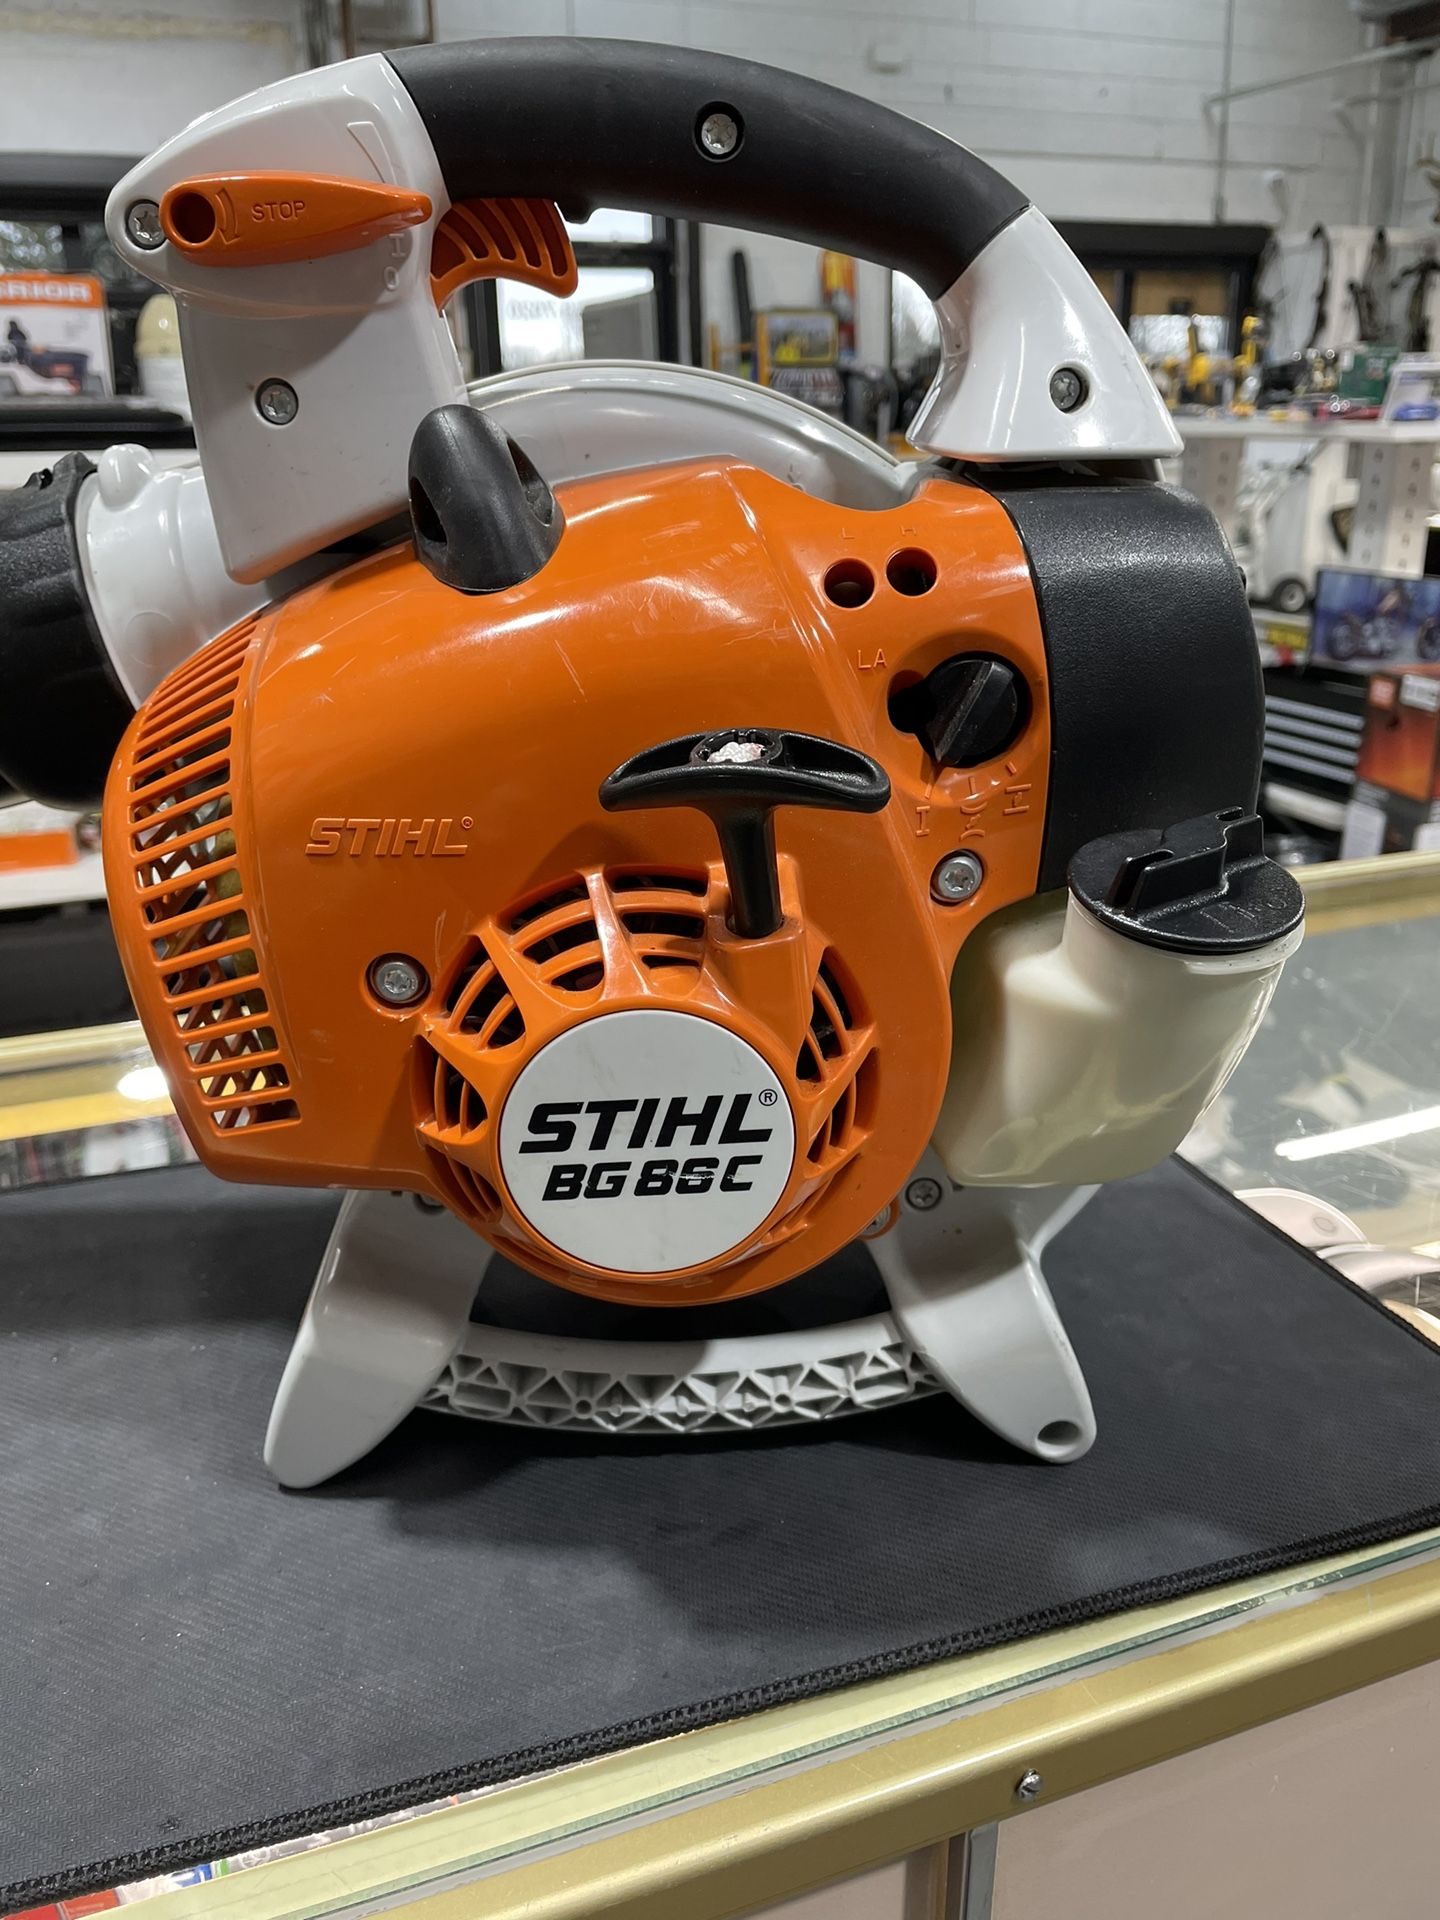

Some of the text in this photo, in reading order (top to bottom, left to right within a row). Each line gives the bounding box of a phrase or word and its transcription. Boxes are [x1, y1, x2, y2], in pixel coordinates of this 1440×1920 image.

[251, 200, 306, 223] STOP
[0, 279, 92, 302] RIOR
[857, 648, 887, 671] LA
[541, 1161, 632, 1201] BG
